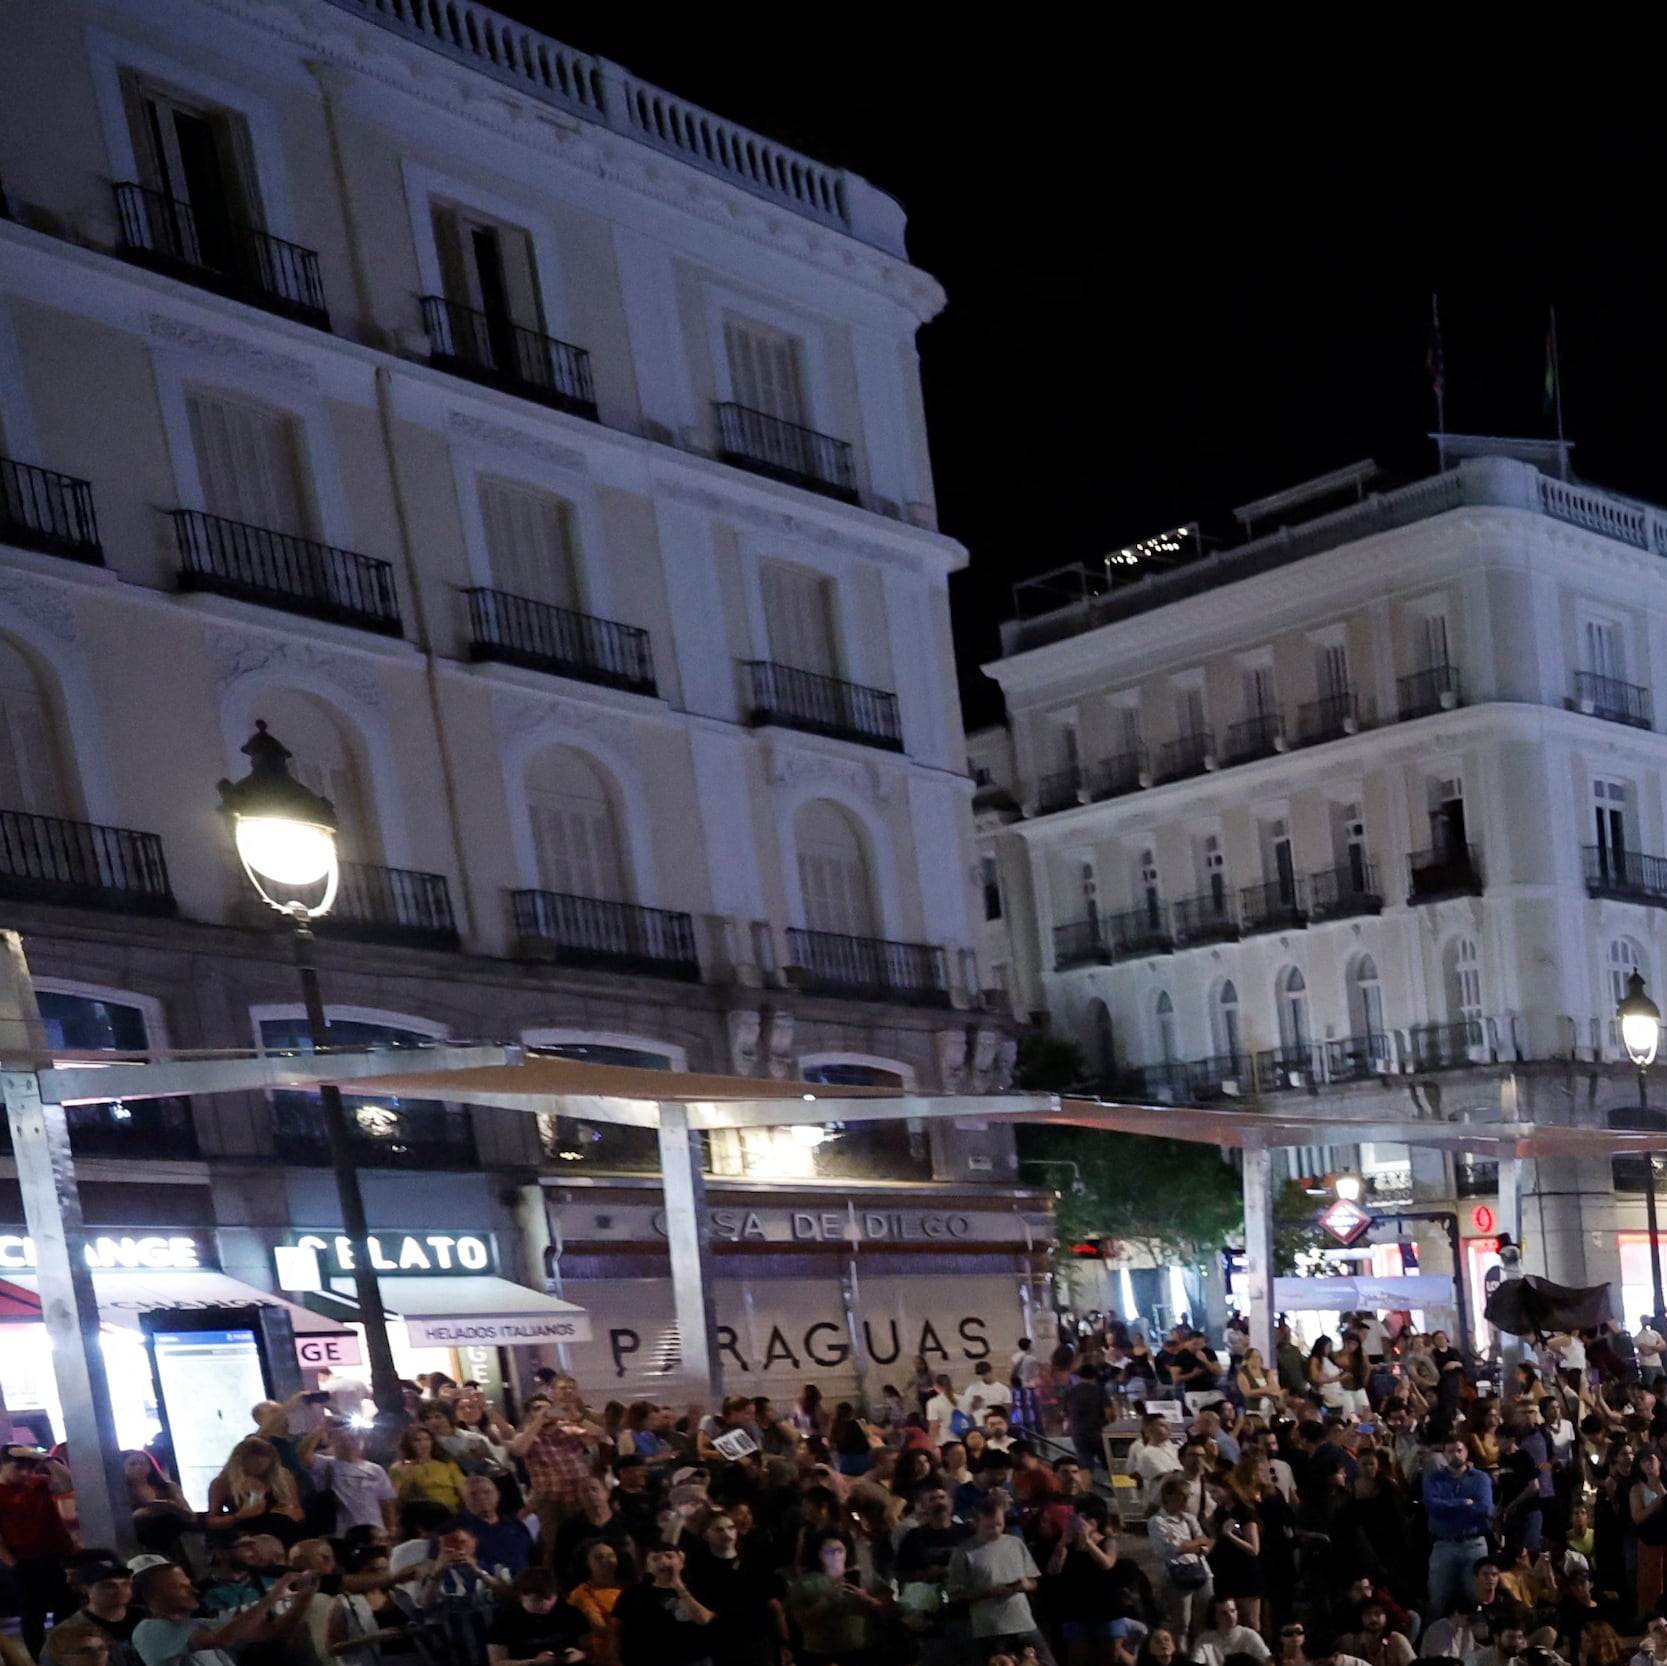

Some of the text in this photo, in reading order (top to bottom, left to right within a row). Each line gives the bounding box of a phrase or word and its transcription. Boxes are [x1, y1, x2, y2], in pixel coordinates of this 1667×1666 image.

[653, 1212, 767, 1240] CSA
[792, 1212, 843, 1241] DE
[424, 1322, 576, 1341] HELADOS ITALIANOS
[609, 1318, 992, 1378] PRAGUAS
